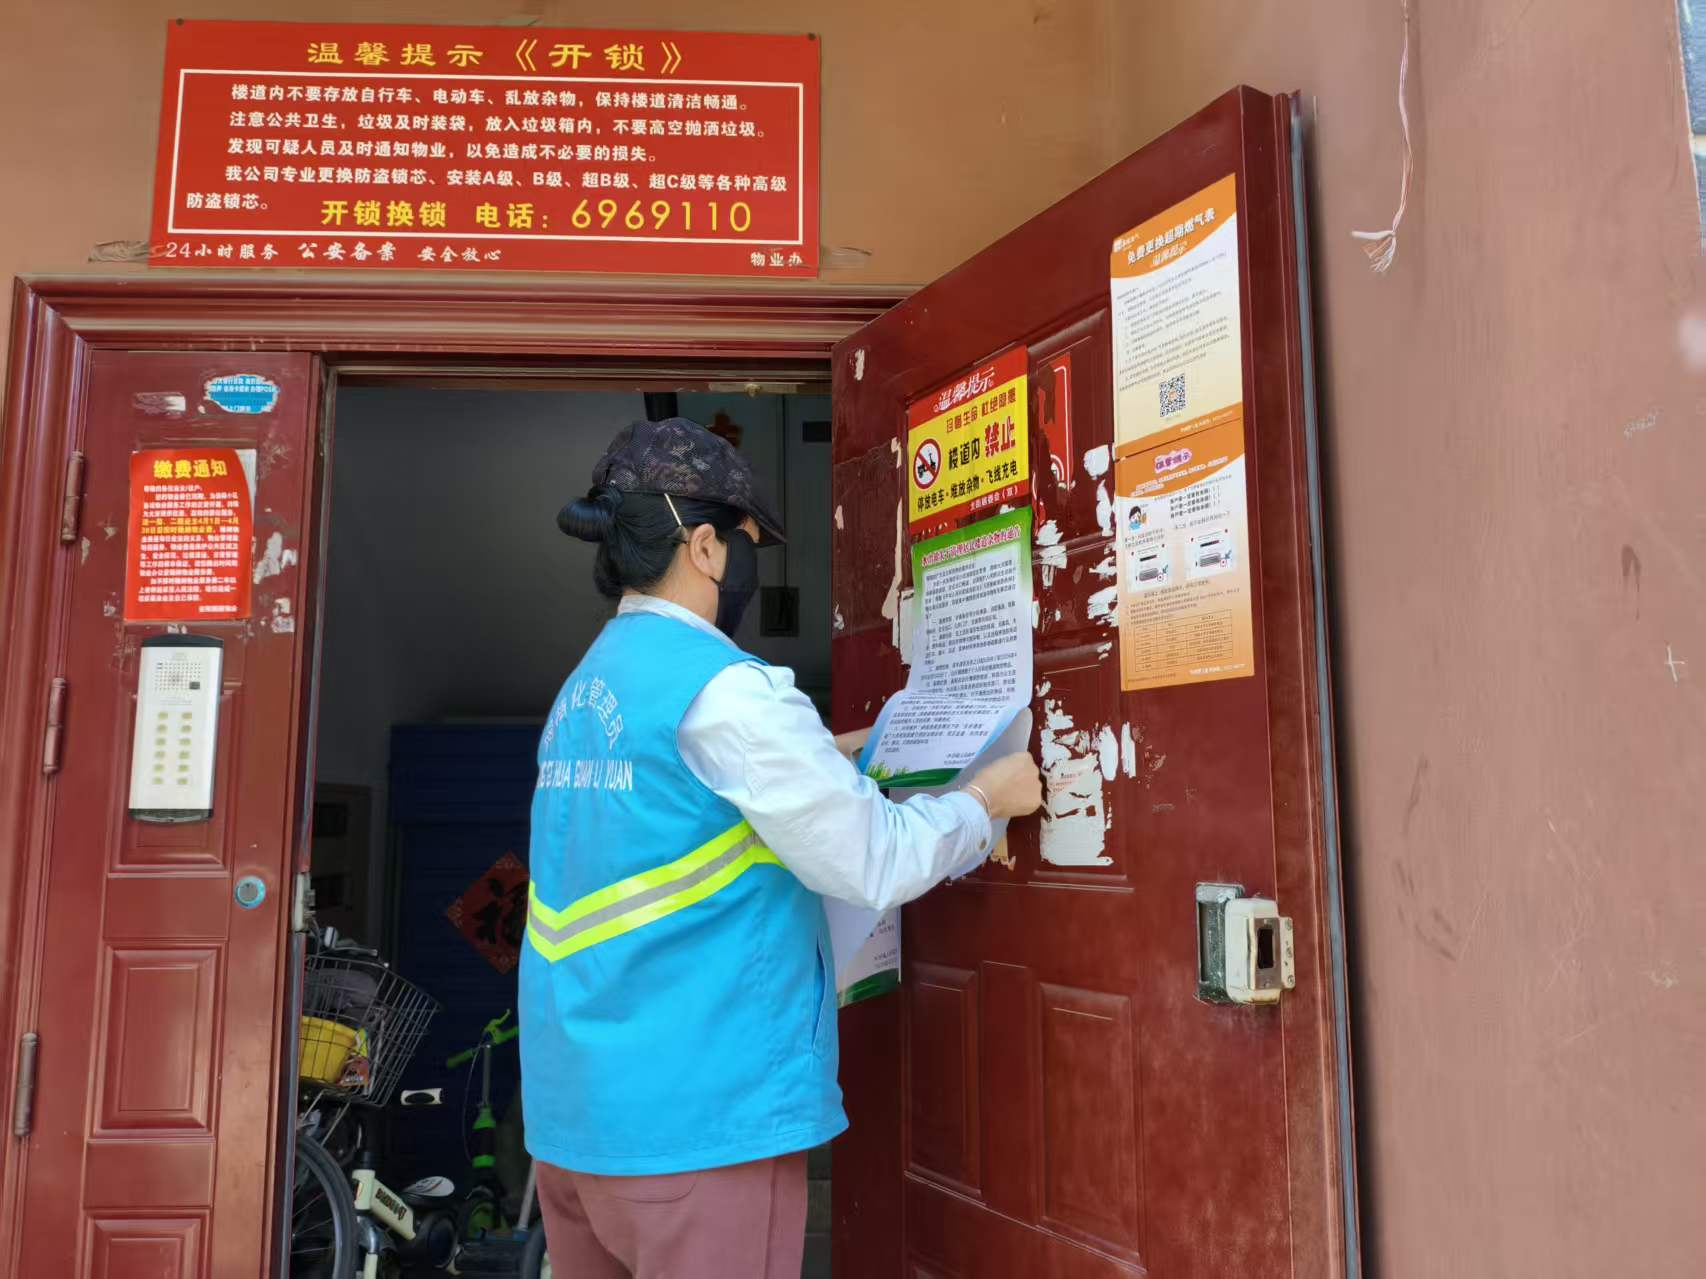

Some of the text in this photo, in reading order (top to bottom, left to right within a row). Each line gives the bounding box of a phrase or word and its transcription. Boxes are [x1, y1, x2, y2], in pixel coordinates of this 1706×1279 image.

[227, 137, 657, 163] 发现可疑人员及时通知物业，以免造成不必要的损失。
[186, 193, 269, 211] 防盗锁芯。
[320, 200, 447, 228] 开锁换锁
[165, 241, 803, 268] 24小时服务 公安备案 安全放心 物业办
[937, 367, 995, 409] 温馨提示
[948, 416, 1016, 471] 楼道内 禁止
[153, 459, 228, 480] 缴费通知
